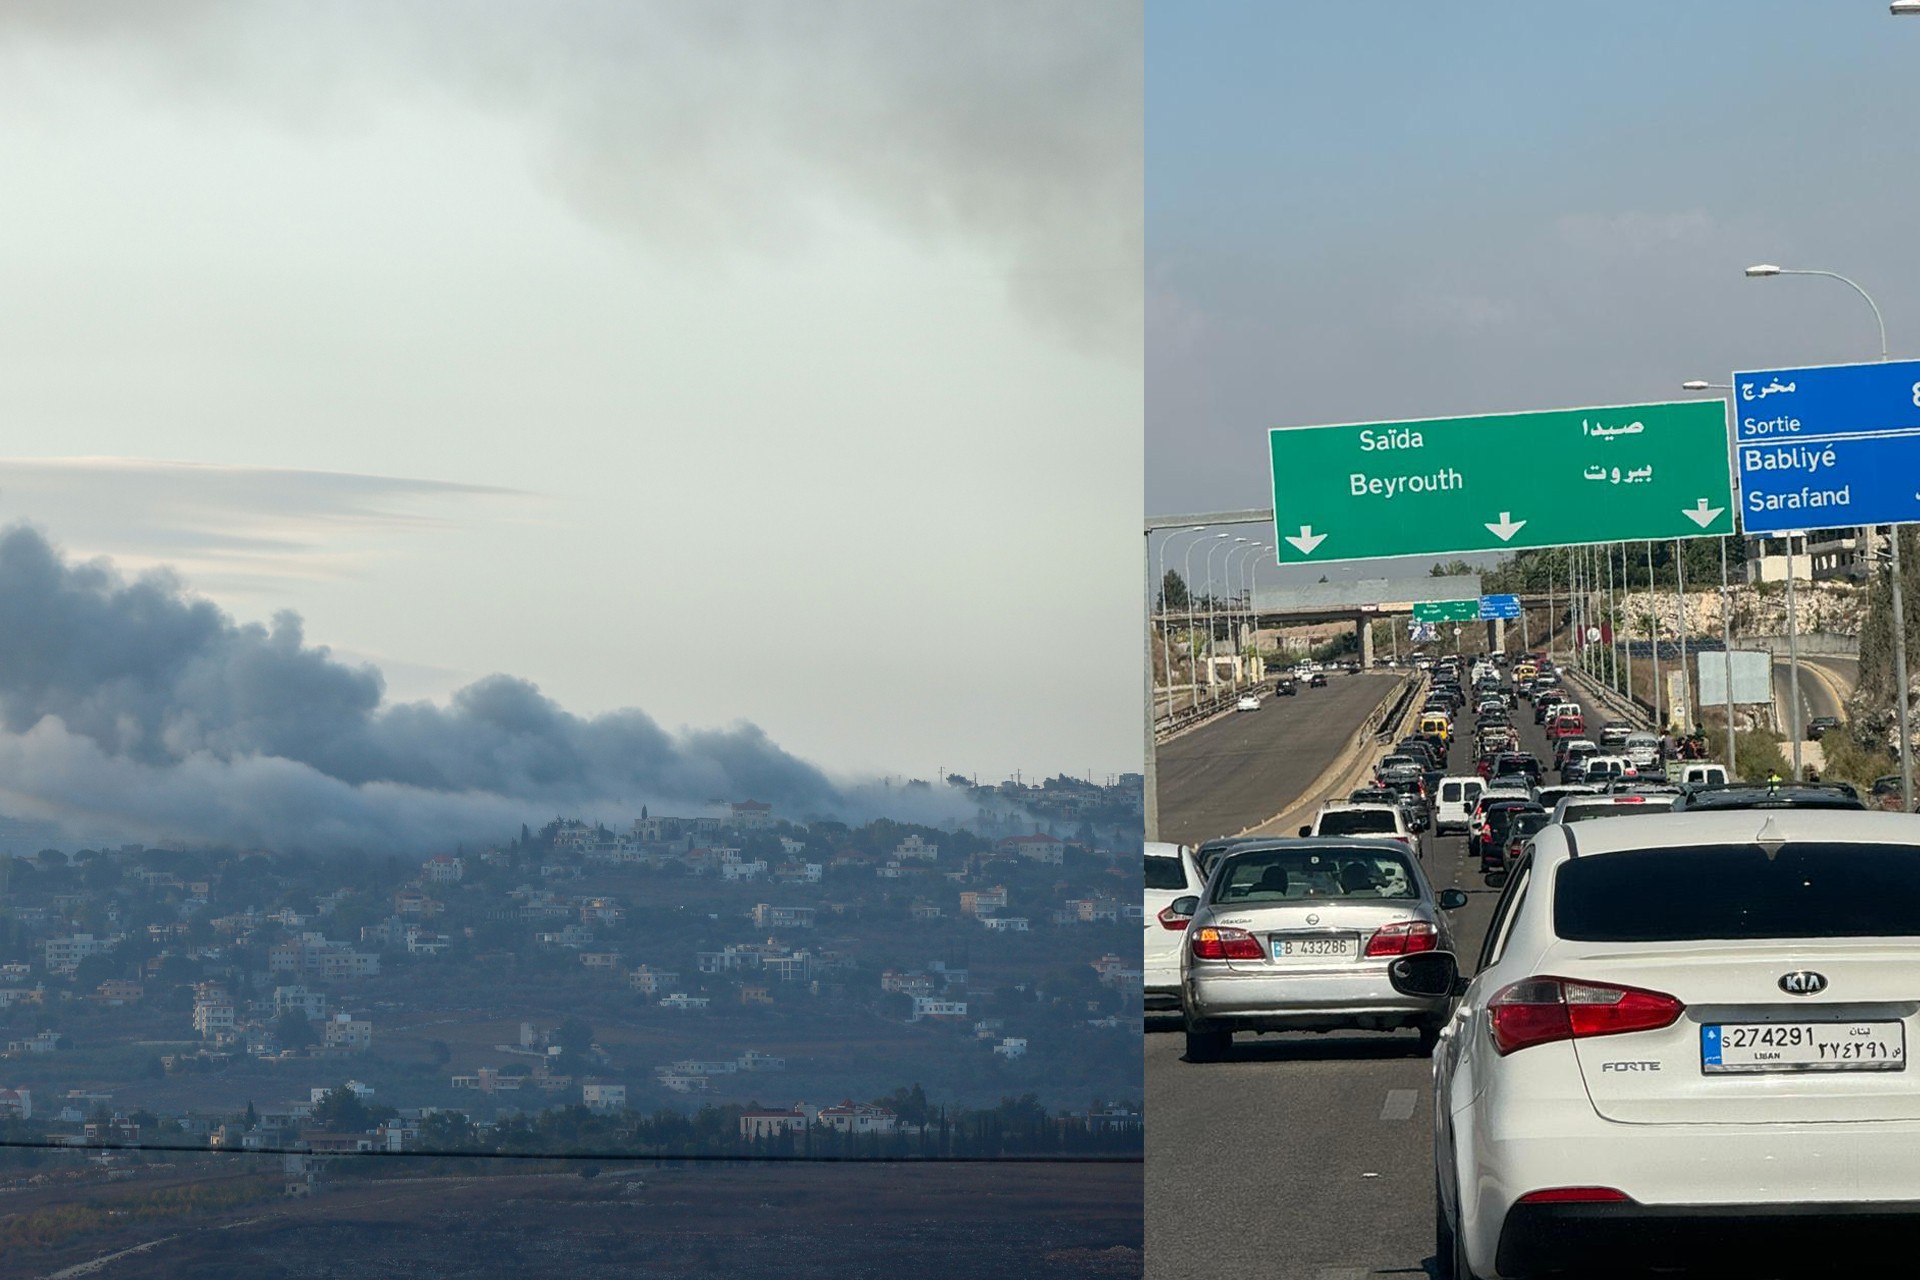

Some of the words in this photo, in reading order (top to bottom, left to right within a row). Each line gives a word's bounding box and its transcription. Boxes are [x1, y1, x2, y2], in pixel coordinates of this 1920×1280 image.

[1742, 377, 1796, 401] مخرج
[1582, 418, 1645, 441] صيدا
[1744, 415, 1801, 435] Sortie
[1359, 427, 1424, 452] Saïda
[1744, 443, 1836, 472] Babliyé
[1349, 467, 1463, 499] Beyrouth
[1583, 463, 1652, 485] بيروت
[1749, 485, 1850, 512] Sarafand
[1284, 940, 1293, 955] B
[1300, 939, 1347, 955] 433286
[1785, 974, 1821, 990] KIA
[1849, 1027, 1871, 1038] لبنان
[1602, 1061, 1661, 1073] FORTE
